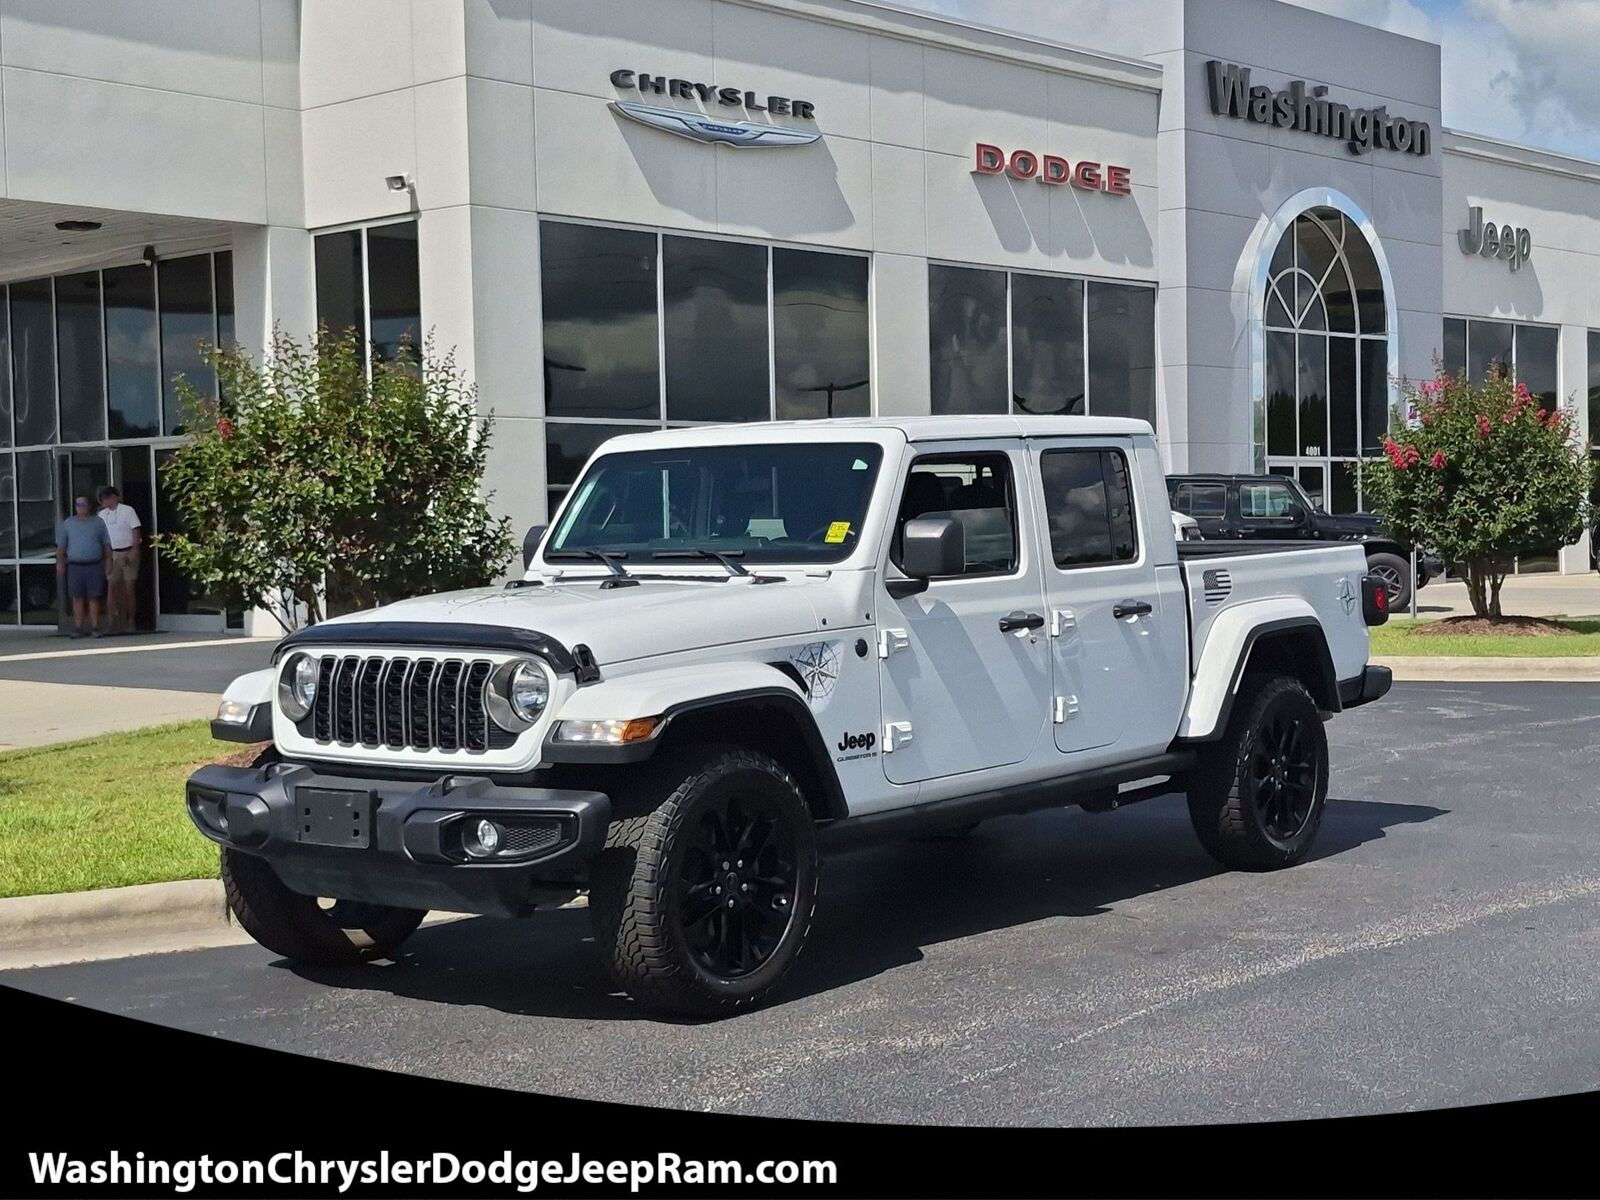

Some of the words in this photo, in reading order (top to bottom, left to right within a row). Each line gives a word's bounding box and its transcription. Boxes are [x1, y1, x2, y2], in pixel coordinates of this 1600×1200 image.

[610, 69, 815, 120] CHRYSLER
[1206, 60, 1432, 156] Washington
[975, 143, 1131, 196] DODGE
[1457, 206, 1531, 272] Jeep
[1305, 446, 1320, 456] 4001
[838, 731, 876, 751] Jeep
